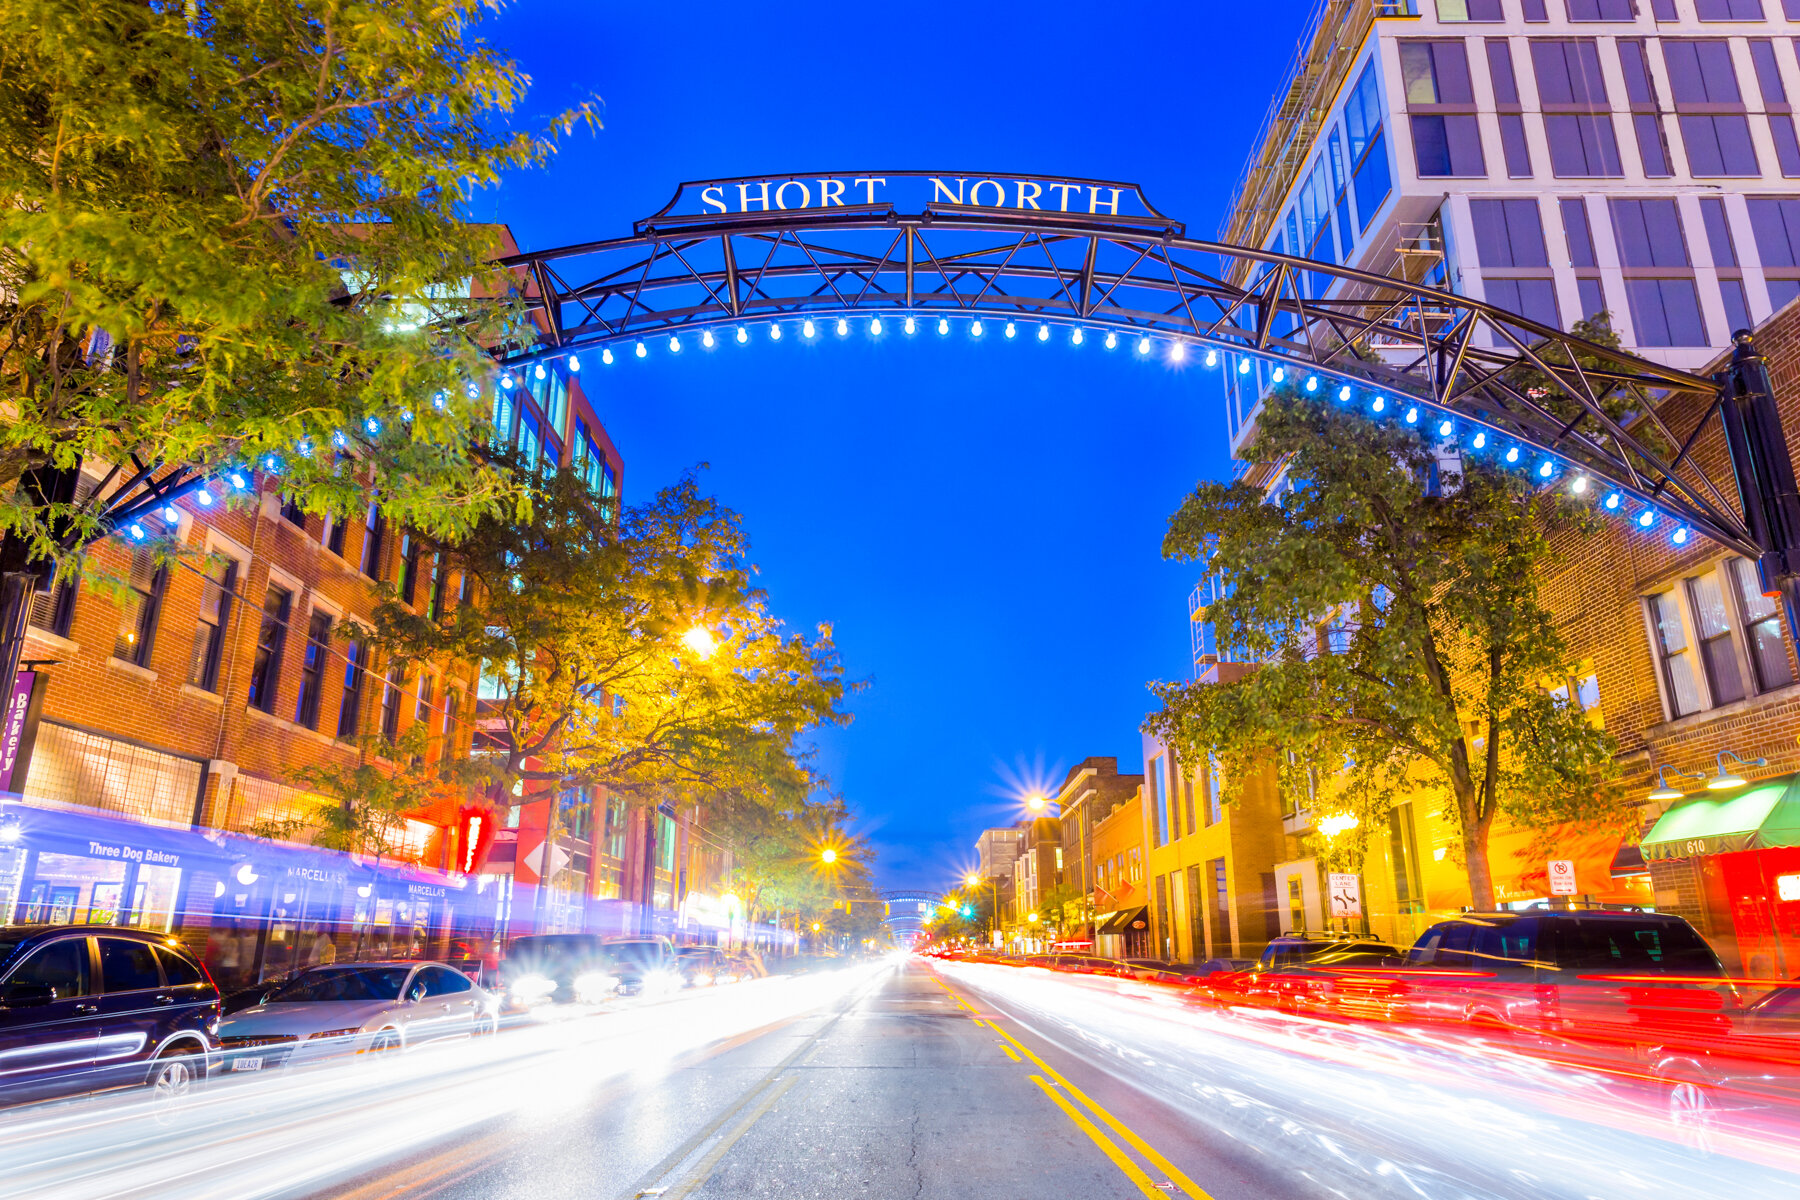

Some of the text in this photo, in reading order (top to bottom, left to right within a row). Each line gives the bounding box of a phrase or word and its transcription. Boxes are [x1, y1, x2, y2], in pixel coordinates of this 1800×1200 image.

[701, 178, 1124, 216] SHORT NORTH
[3, 693, 28, 771] Bakery
[89, 841, 180, 867] Three Dog Bakery
[1687, 839, 1705, 854] 610
